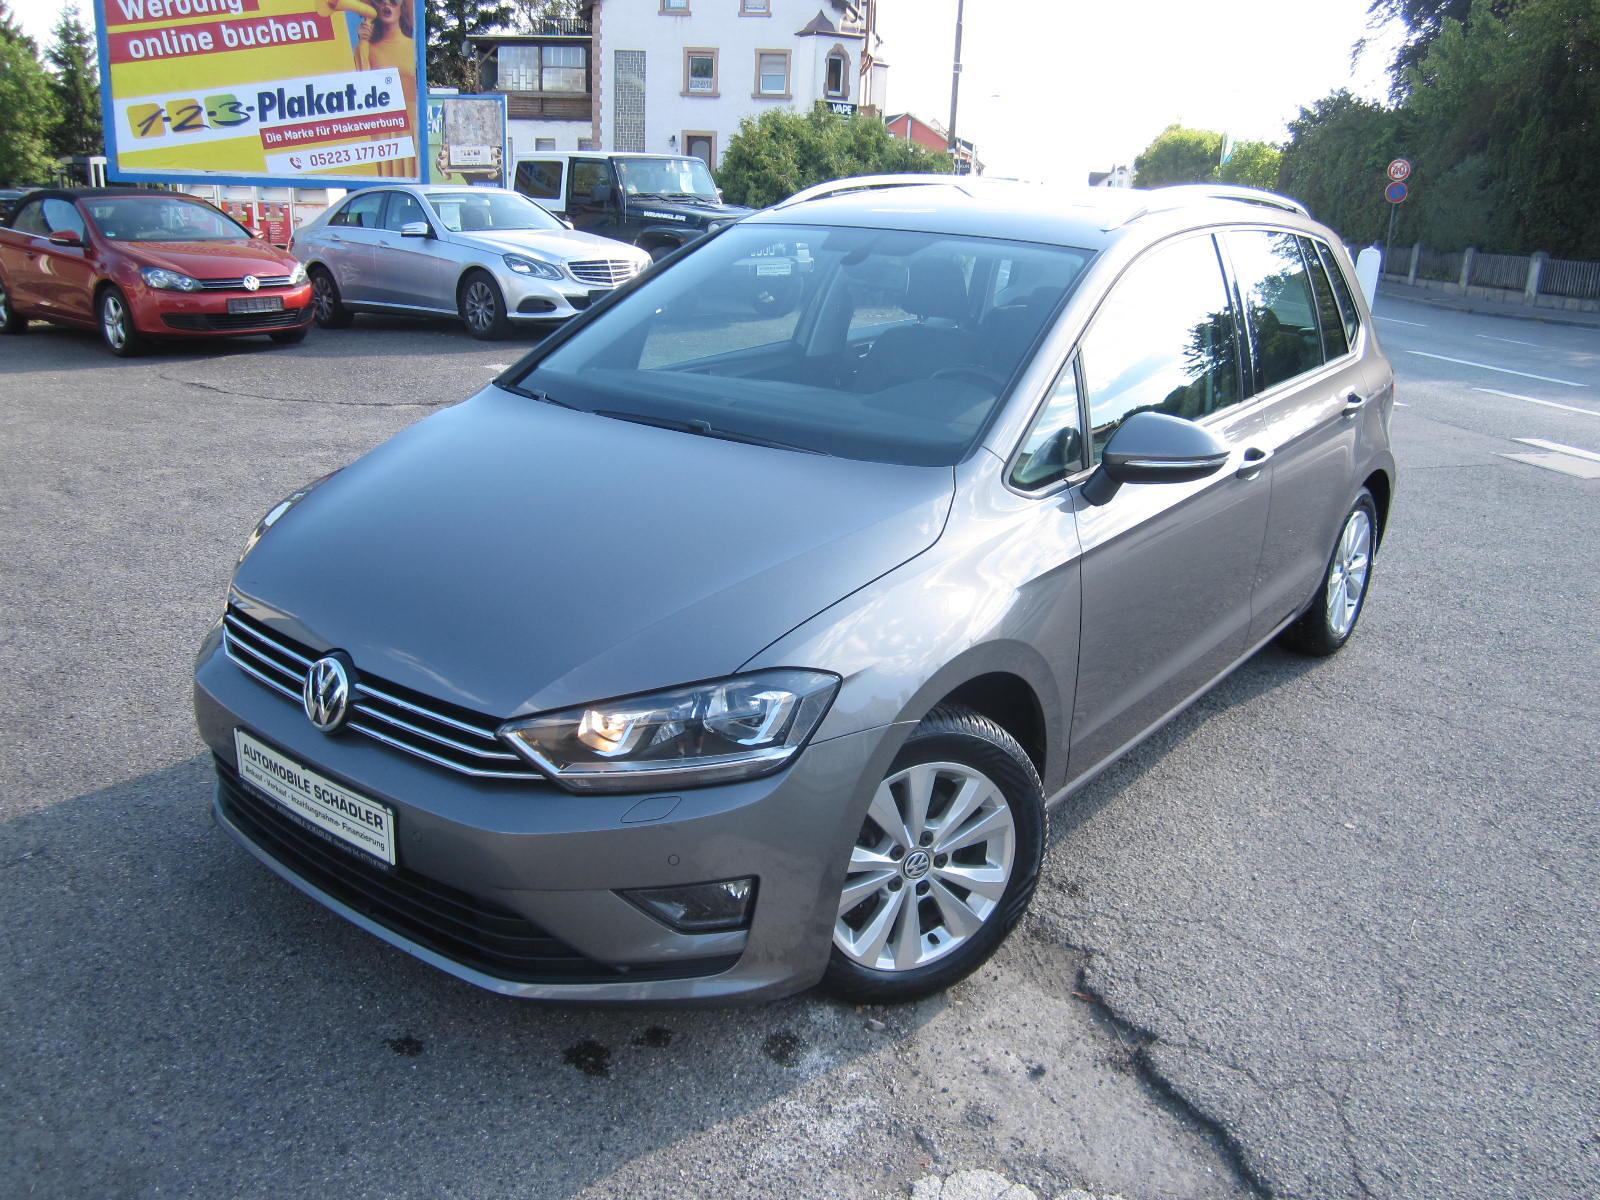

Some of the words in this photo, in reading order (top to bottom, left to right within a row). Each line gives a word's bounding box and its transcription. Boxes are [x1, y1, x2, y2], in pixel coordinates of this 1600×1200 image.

[128, 30, 214, 59] online
[220, 19, 319, 48] buchen
[832, 103, 853, 115] VAPE
[265, 132, 283, 143] Die
[284, 128, 315, 141] Marke
[316, 125, 331, 137] für
[332, 117, 405, 135] Plakatwerbung
[310, 150, 351, 167] 05223
[355, 146, 376, 160] 177
[378, 143, 399, 157] 877
[643, 210, 687, 222] WRANGLER
[243, 743, 311, 794] AUTOMOBILE
[313, 784, 384, 831] SCHÄDLER
[341, 822, 385, 852] Finanzierung
